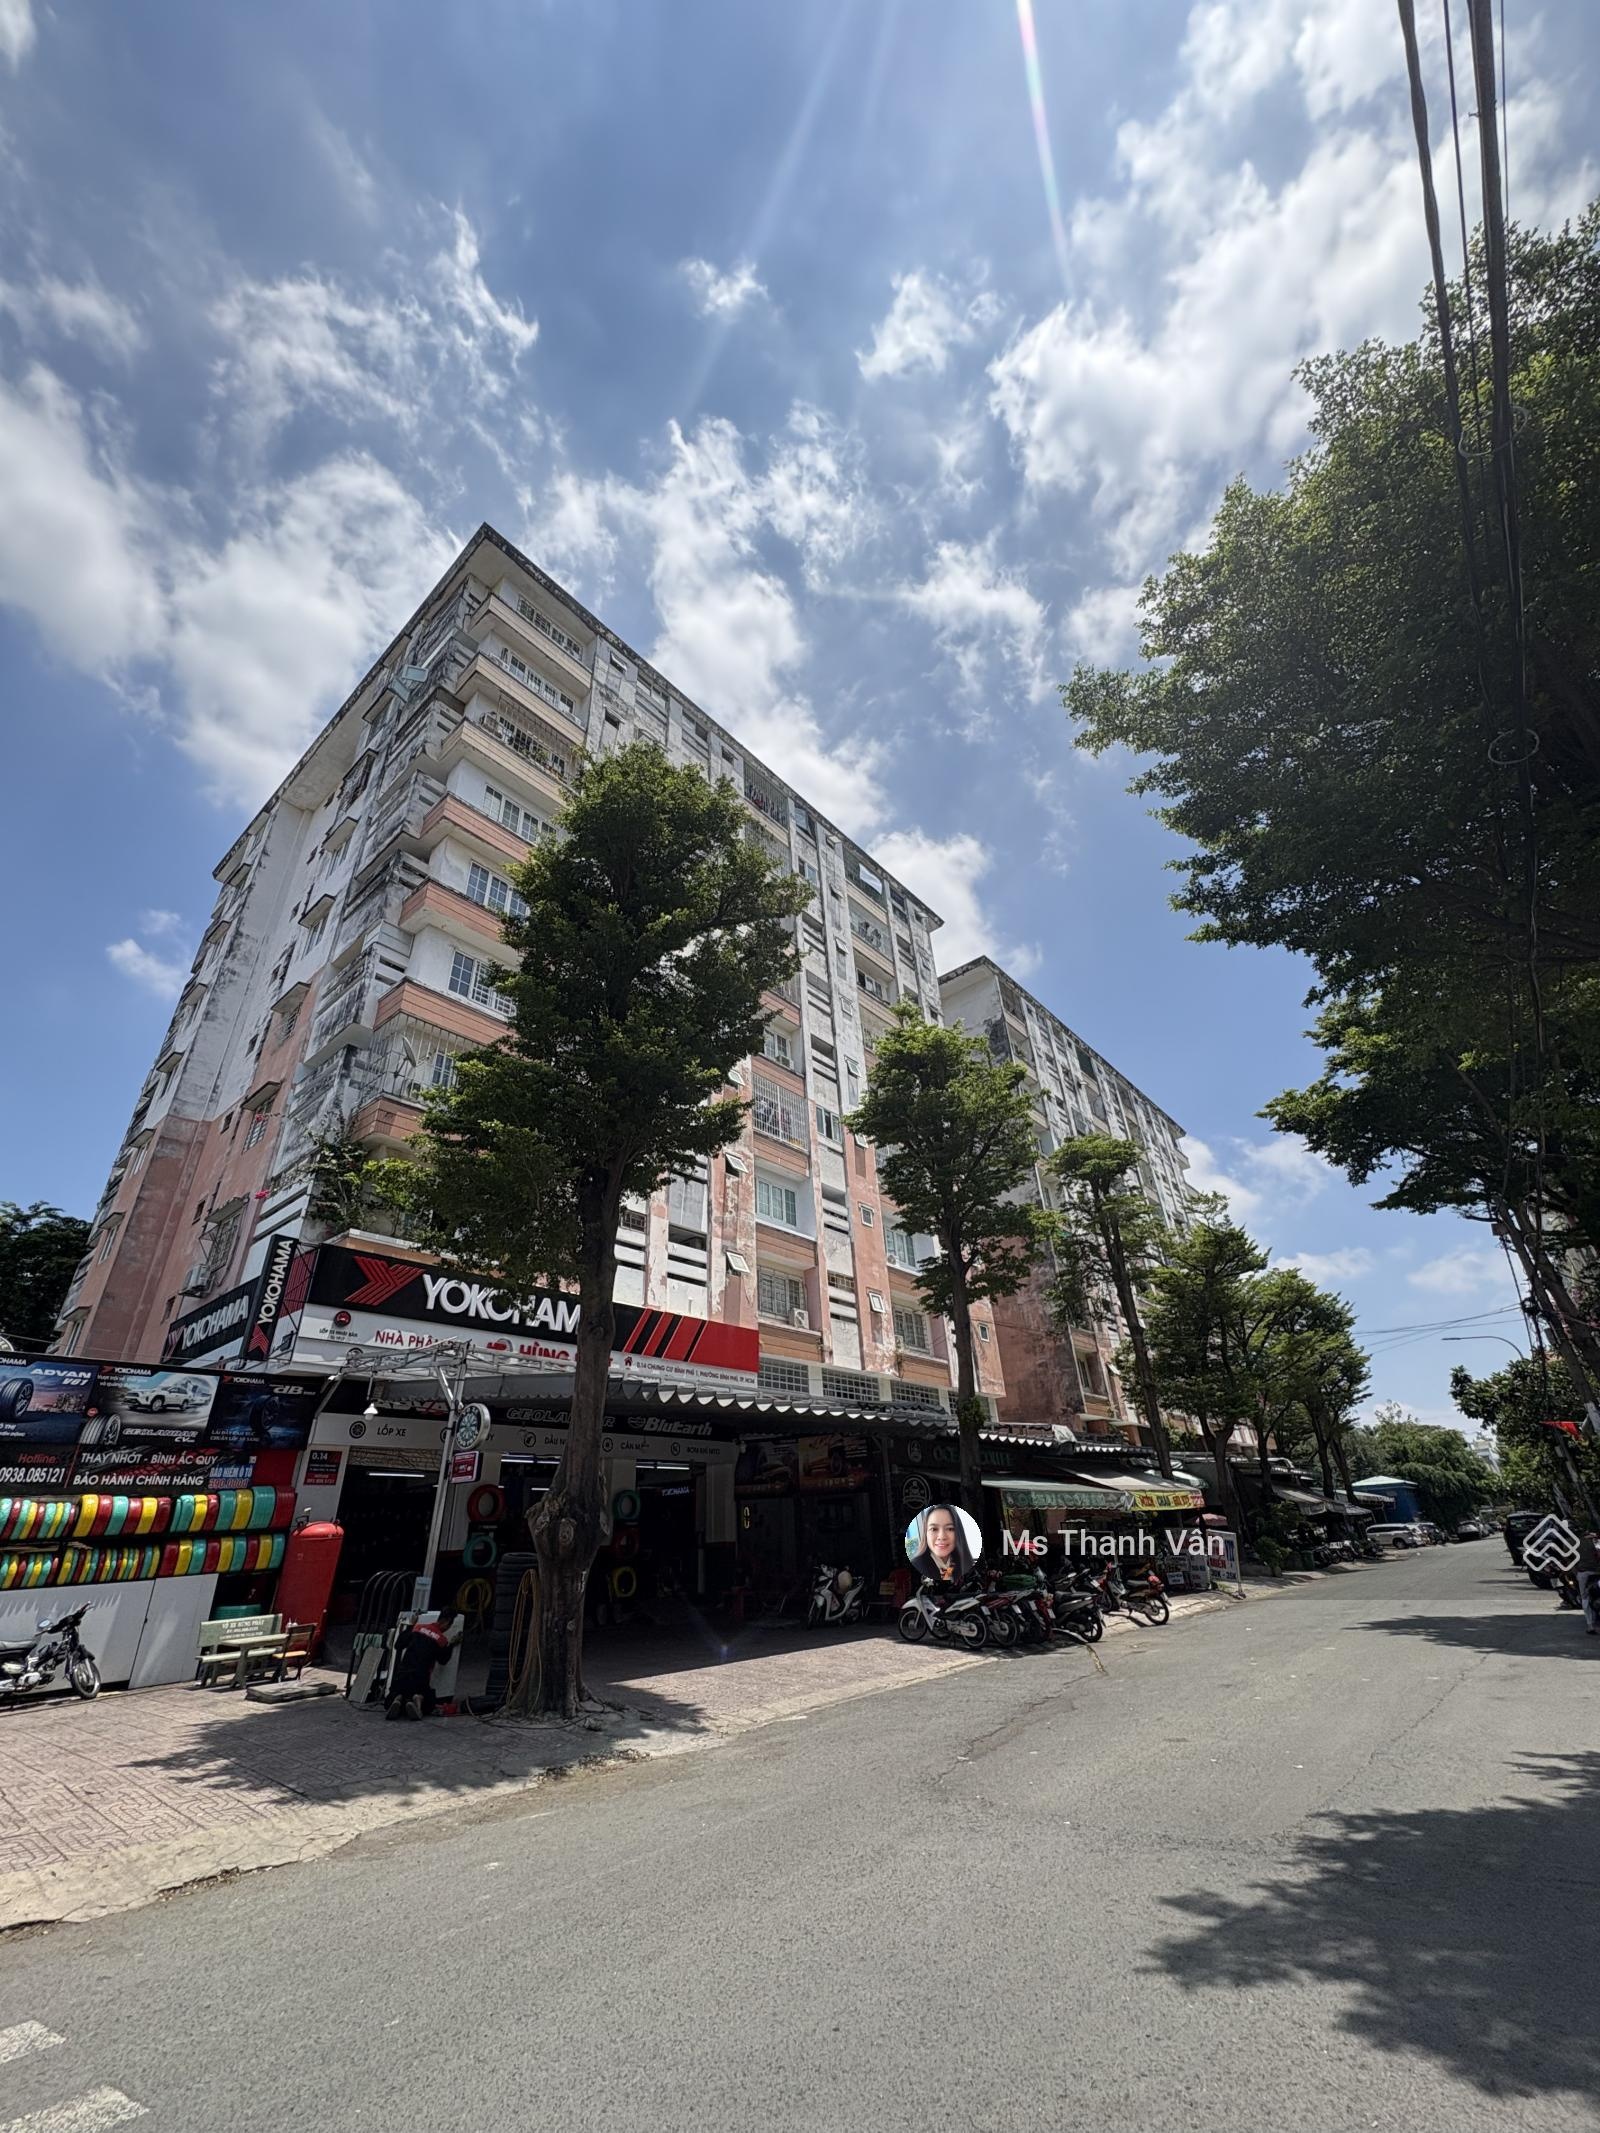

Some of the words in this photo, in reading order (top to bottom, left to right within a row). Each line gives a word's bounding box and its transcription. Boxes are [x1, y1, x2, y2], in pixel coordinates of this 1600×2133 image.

[257, 1239, 294, 1324] YOKOHAMA
[423, 1273, 581, 1335] YOKOHAM
[181, 1295, 250, 1350] YOKOHAMA
[375, 1329, 404, 1347] NHÀ
[30, 1368, 92, 1380] ADVAN
[114, 1367, 152, 1376] YOKOHAMA
[232, 1377, 265, 1385] YOKOHAMA
[377, 1423, 394, 1437] LỐP
[396, 1427, 408, 1437] XE
[644, 1416, 713, 1436] BluEarth
[81, 1453, 112, 1463] THAY
[111, 1452, 142, 1464] NHỚT
[151, 1451, 176, 1465] BÌNH
[195, 1455, 218, 1465] QUY
[0, 1467, 66, 1483] 0938.085121
[73, 1470, 99, 1486] BẢO
[101, 1472, 134, 1486] HÀNH
[136, 1472, 174, 1486] CHÍNH
